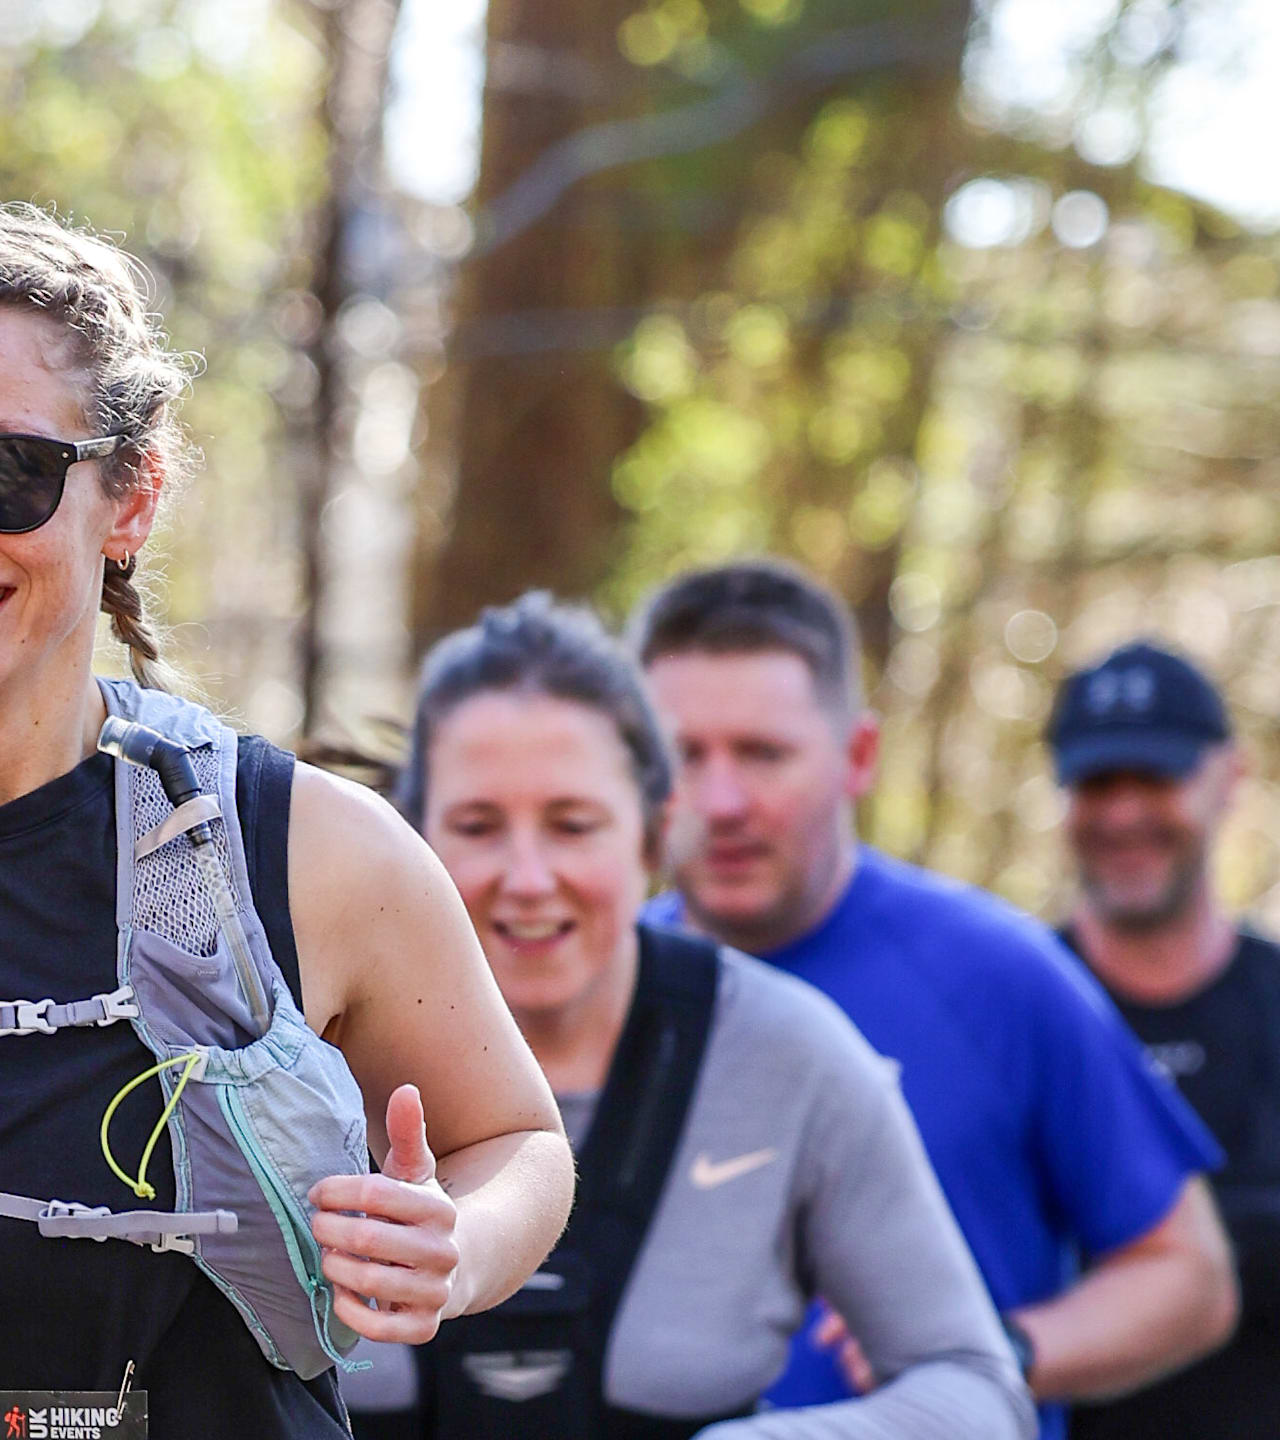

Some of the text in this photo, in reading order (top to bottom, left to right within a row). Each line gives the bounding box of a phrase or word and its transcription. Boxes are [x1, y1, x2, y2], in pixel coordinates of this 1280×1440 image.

[29, 1408, 48, 1439] UK
[51, 1407, 120, 1427] HIKING
[51, 1427, 101, 1440] EVENTS
